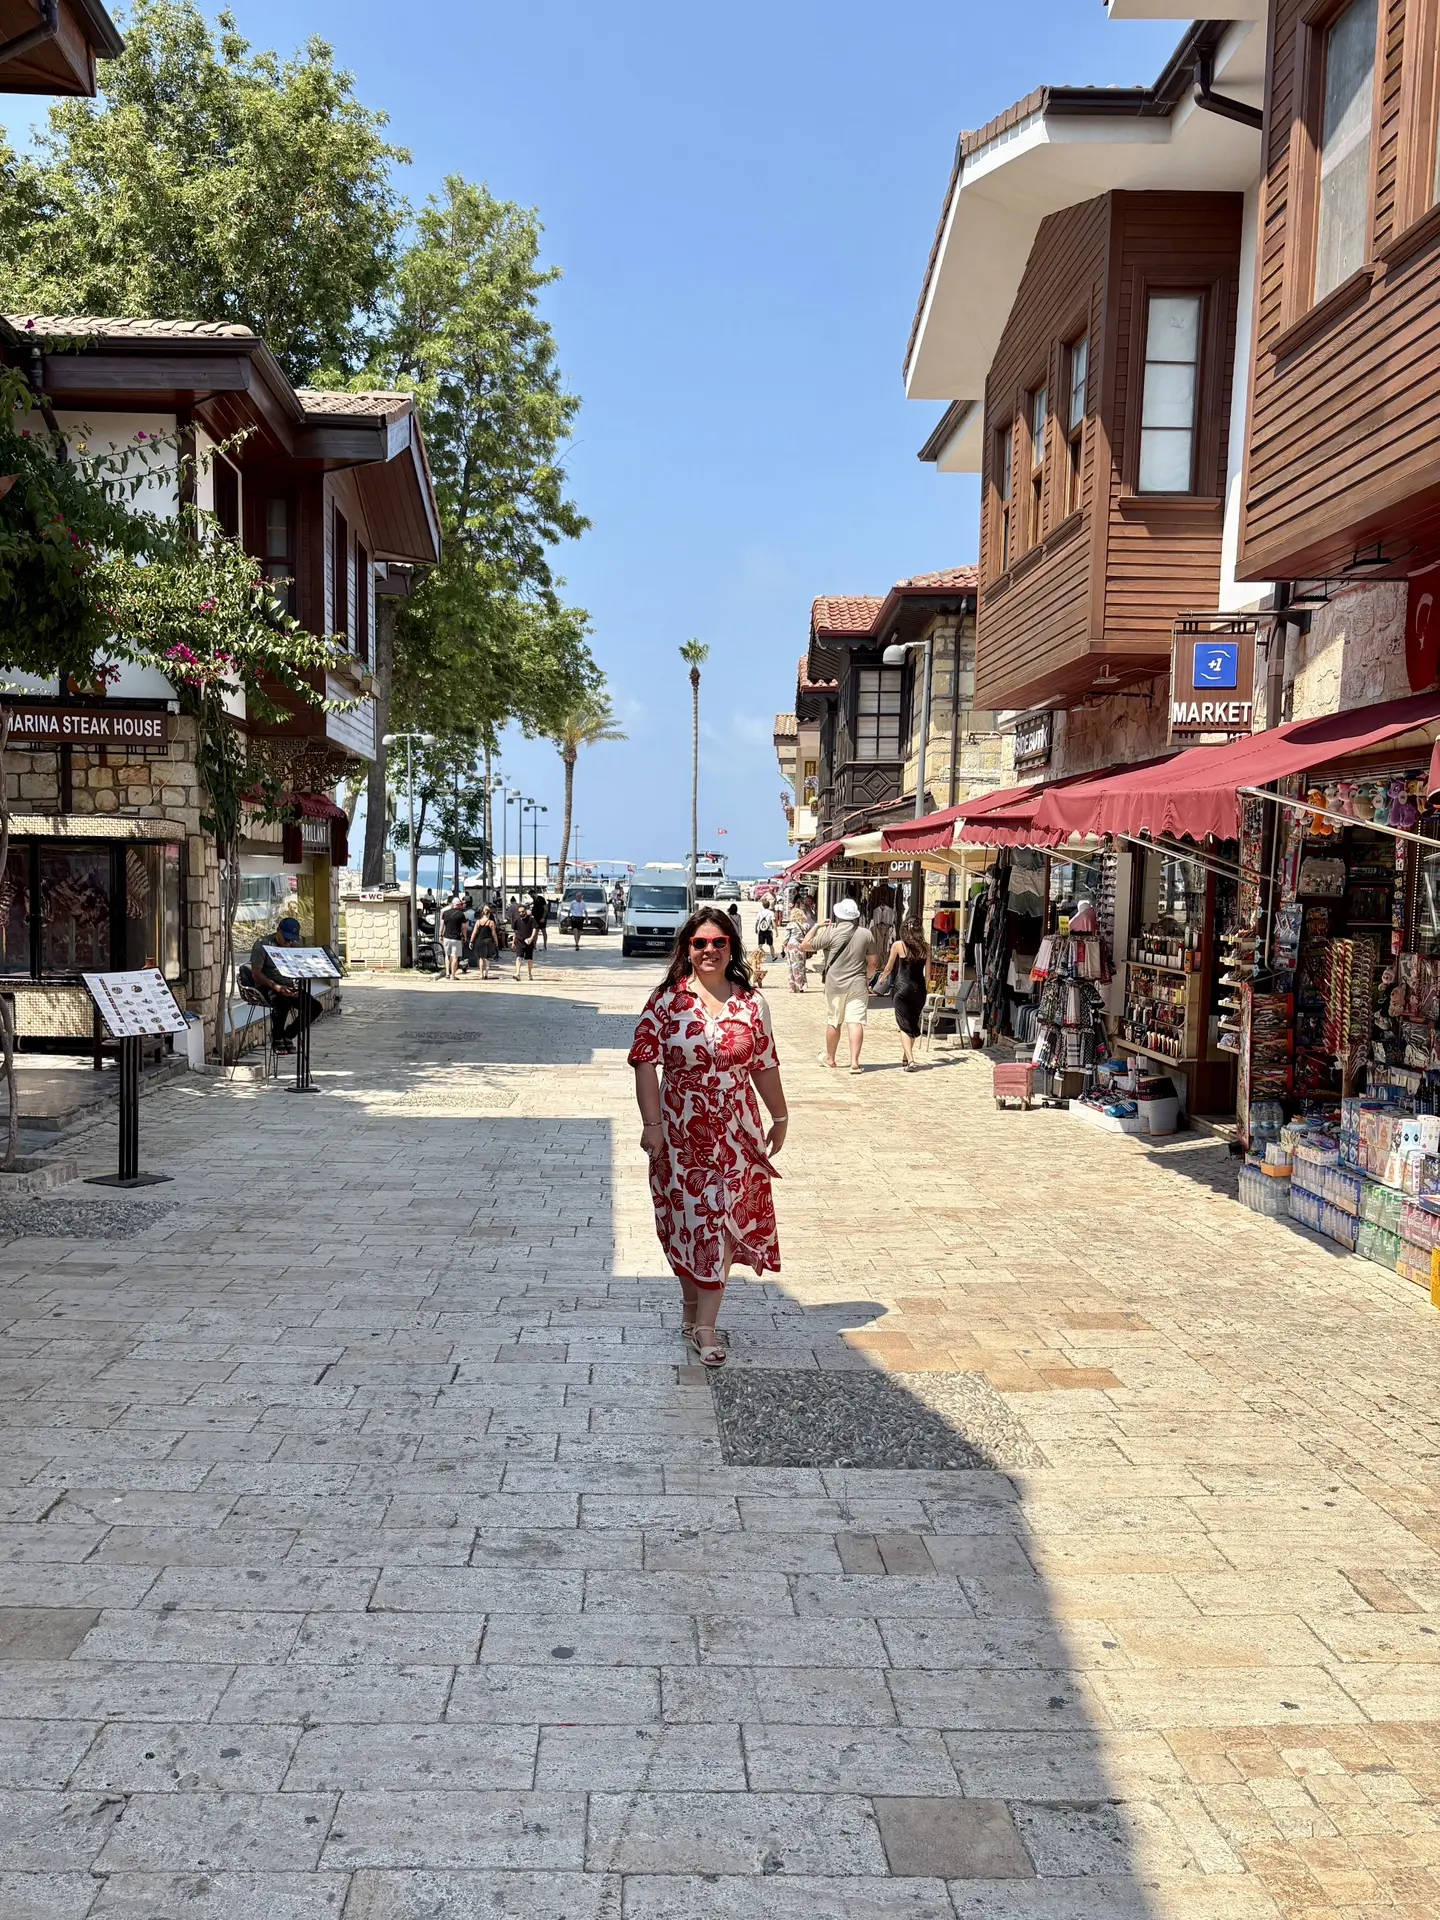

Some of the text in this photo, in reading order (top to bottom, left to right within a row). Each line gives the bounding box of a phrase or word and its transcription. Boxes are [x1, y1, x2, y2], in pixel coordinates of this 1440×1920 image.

[1173, 701, 1252, 723] MARKET
[62, 716, 110, 736] STEAK
[113, 718, 162, 737] HOUSE
